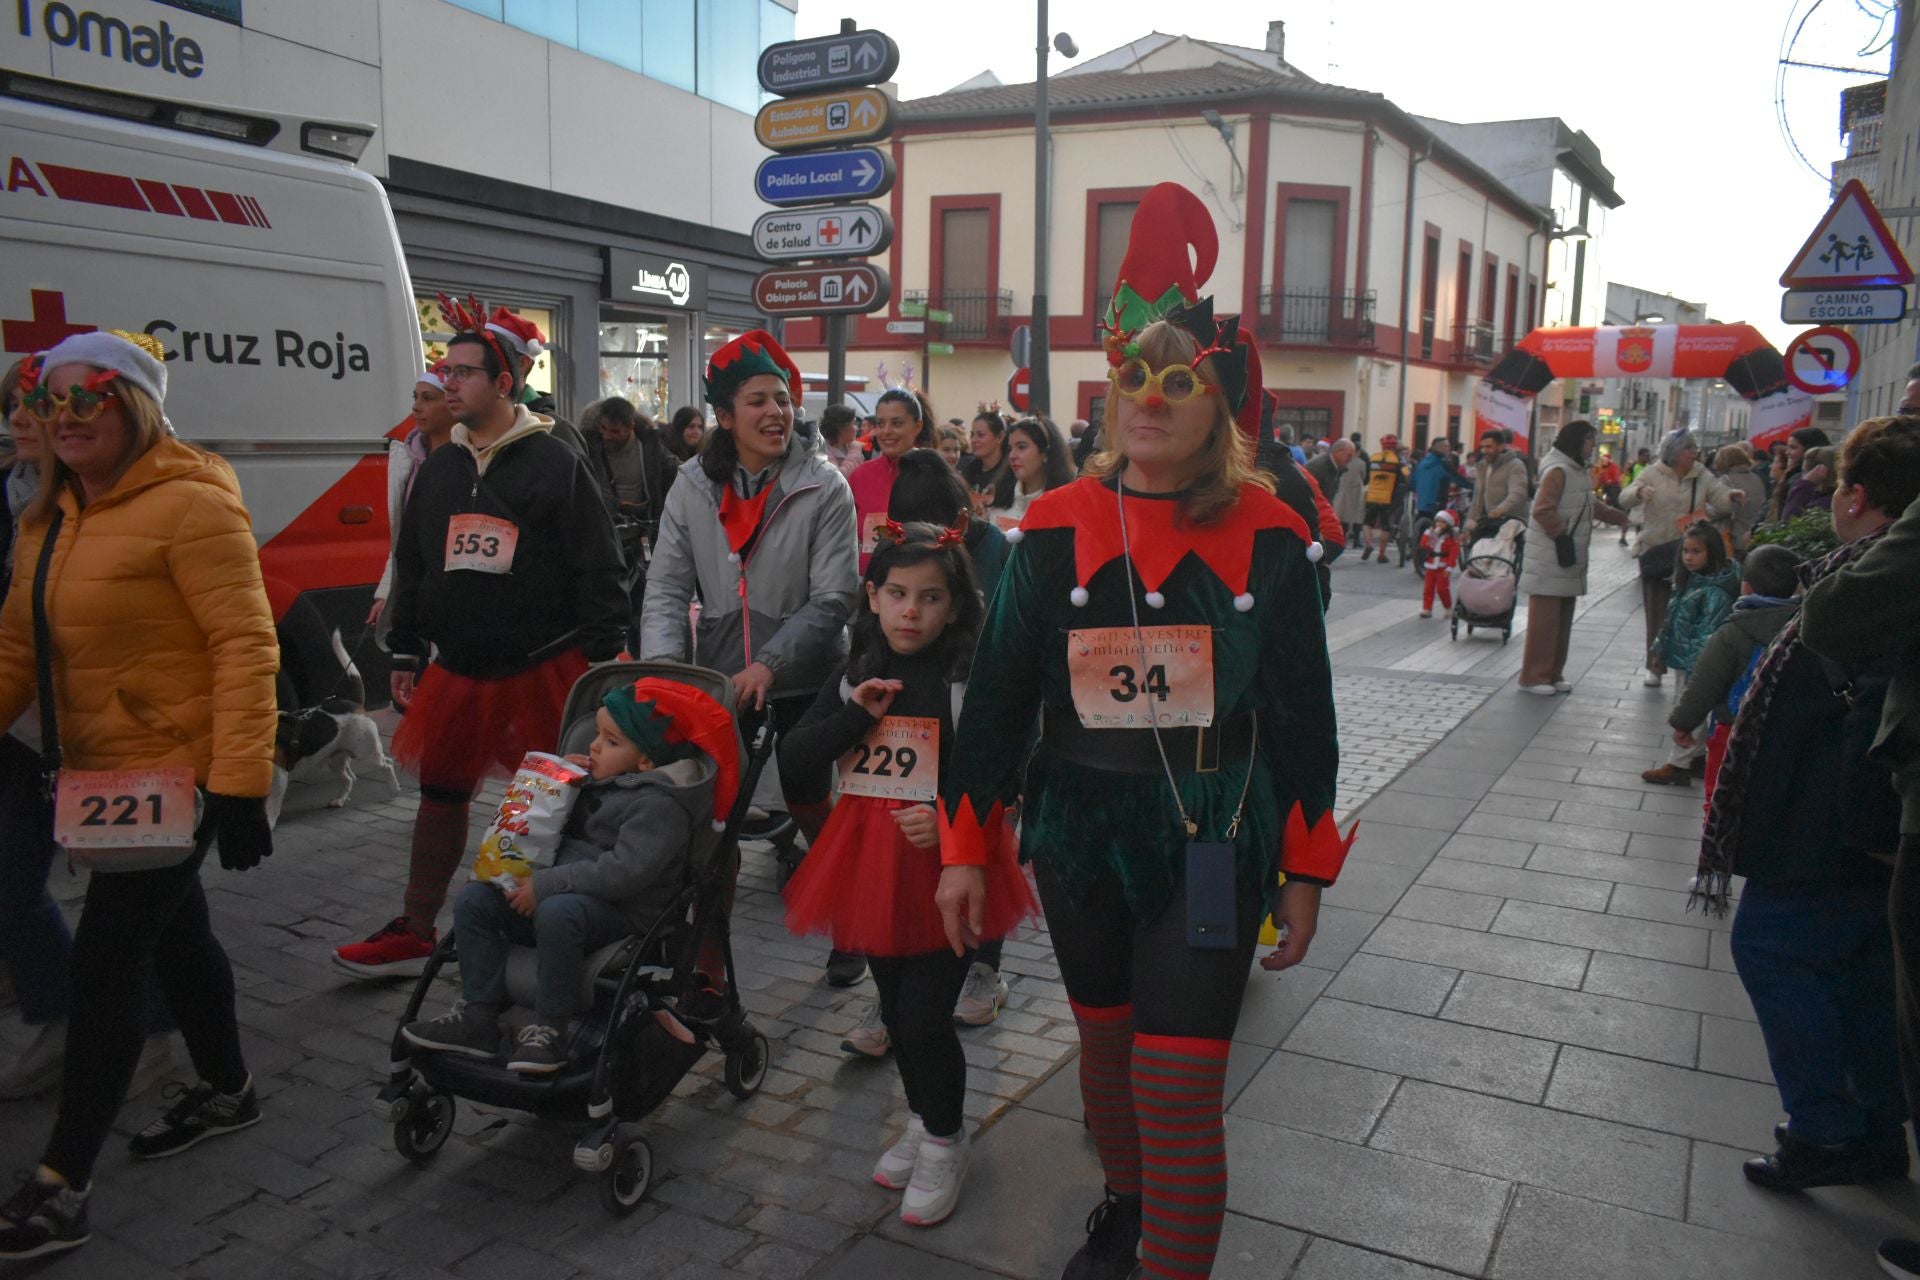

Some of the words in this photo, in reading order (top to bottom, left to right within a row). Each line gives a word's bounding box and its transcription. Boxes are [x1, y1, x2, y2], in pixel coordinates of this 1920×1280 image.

[772, 65, 821, 83] Industrial
[0, 157, 48, 197] A
[810, 169, 842, 184] Local
[766, 221, 802, 233] Centro
[766, 238, 779, 249] de
[782, 236, 811, 247] Salud
[774, 278, 808, 290] Palacio
[765, 291, 797, 303] Obispo
[1815, 293, 1870, 305] CAMINO
[1808, 305, 1874, 318] ESCOLAR
[143, 319, 262, 366] Cruz
[275, 329, 371, 381] Roja
[453, 533, 500, 557] 553
[1109, 664, 1170, 703] 34
[852, 743, 918, 778] 229
[79, 794, 162, 826] 221
